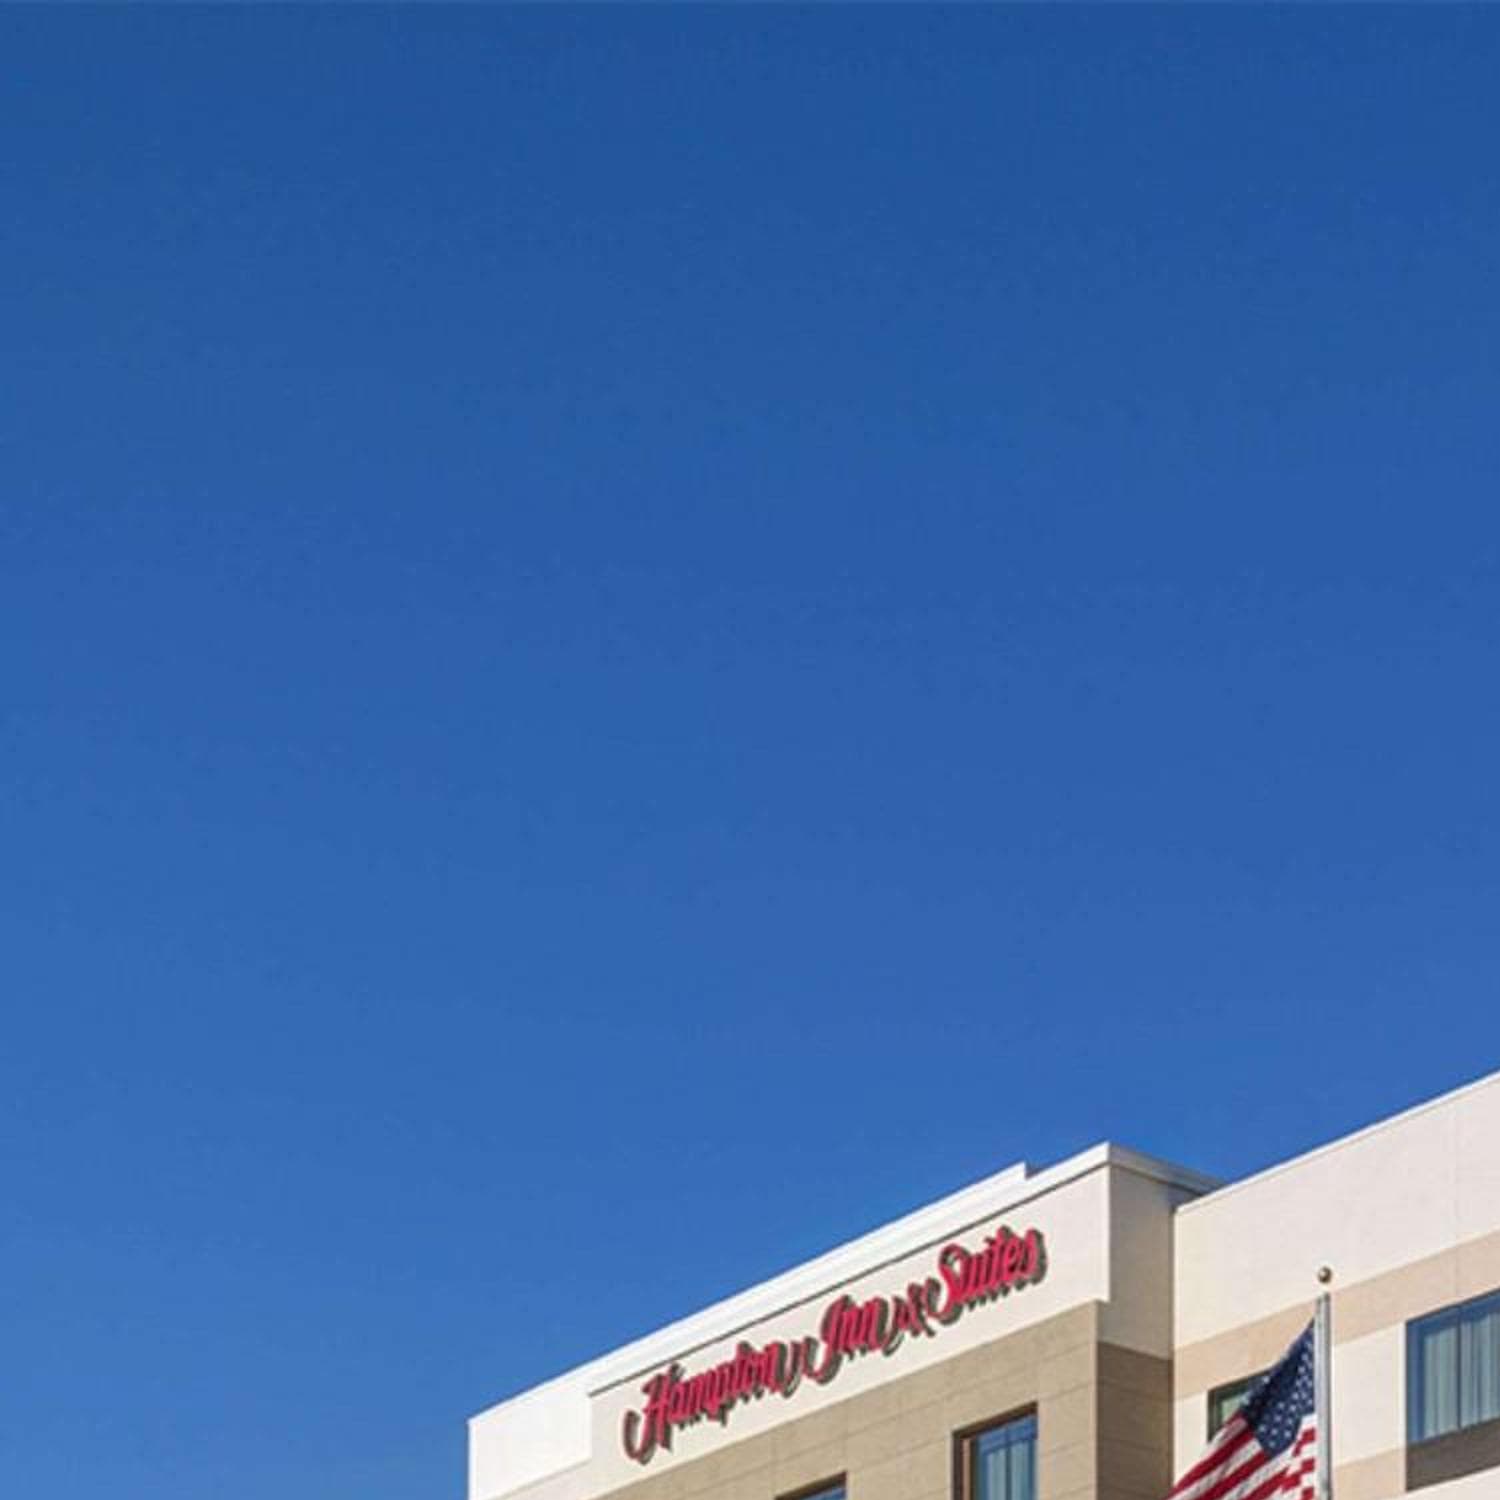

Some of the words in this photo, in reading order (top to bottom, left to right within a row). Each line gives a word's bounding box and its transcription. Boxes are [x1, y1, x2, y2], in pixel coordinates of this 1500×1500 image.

[624, 1340, 808, 1466] Hampton
[802, 1294, 905, 1384] Inn
[926, 1225, 1048, 1327] Suites
